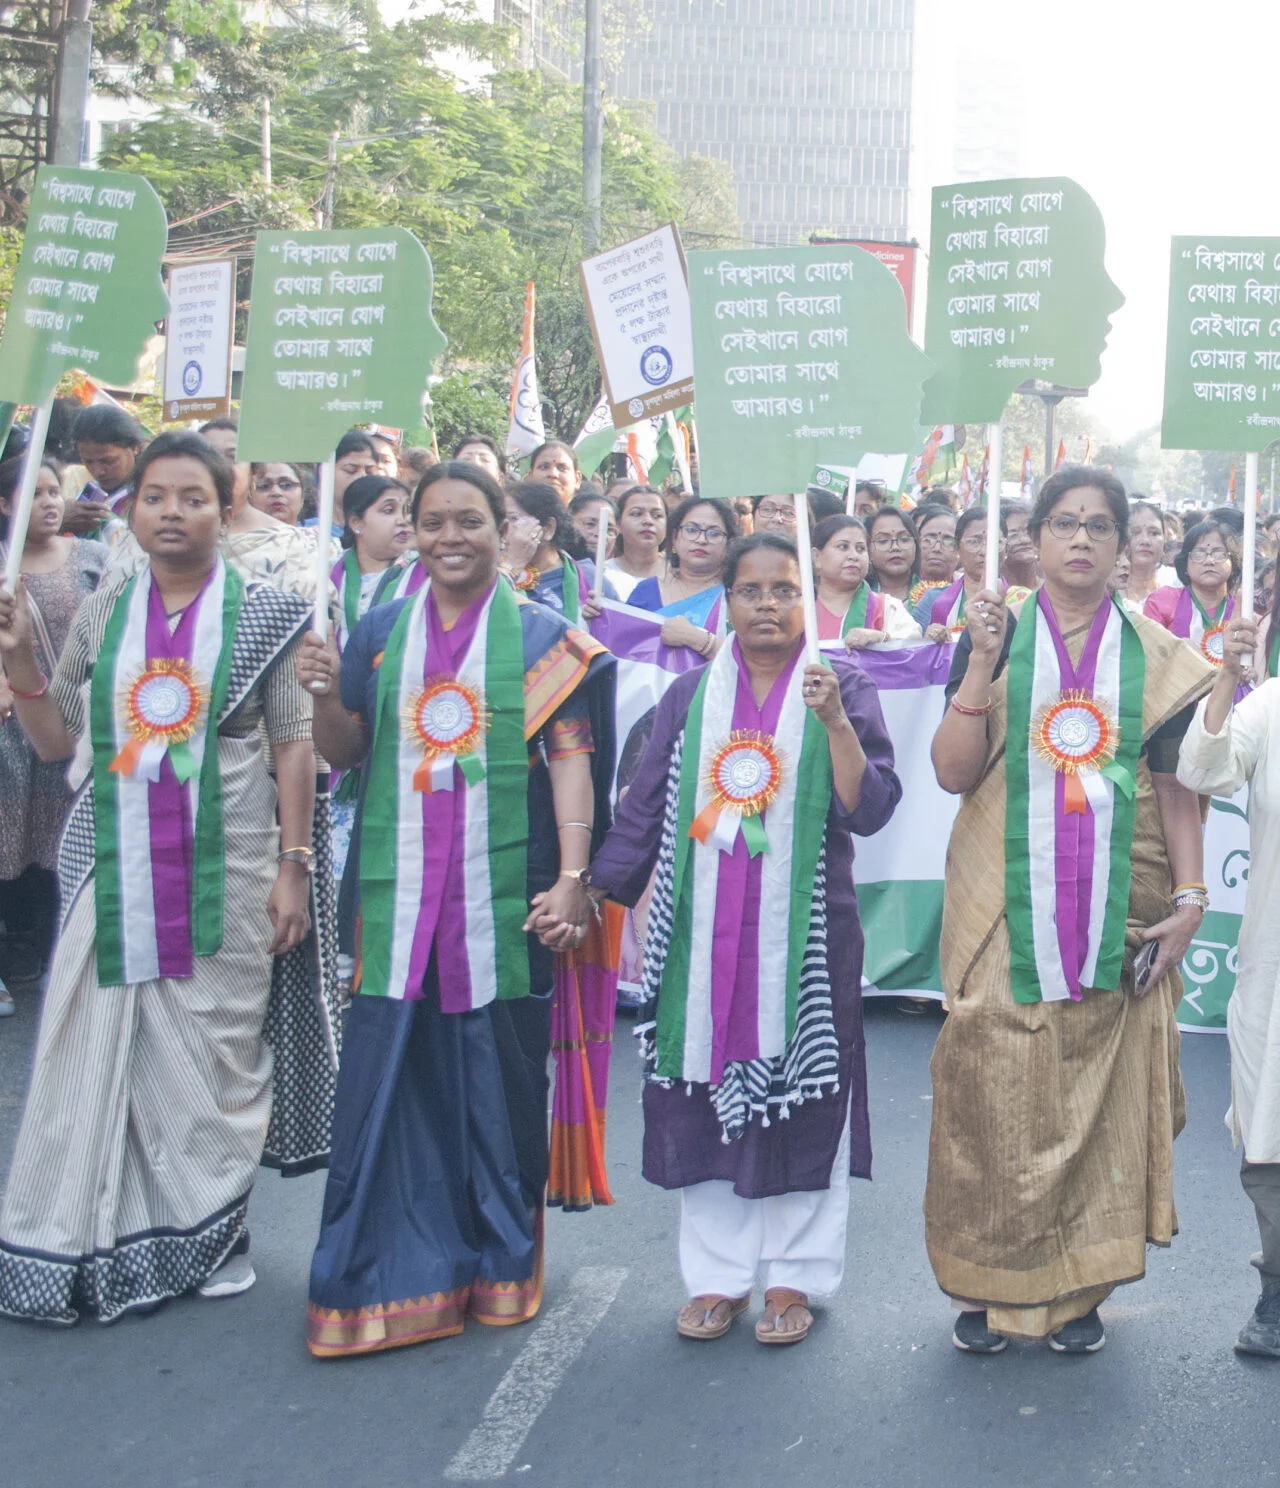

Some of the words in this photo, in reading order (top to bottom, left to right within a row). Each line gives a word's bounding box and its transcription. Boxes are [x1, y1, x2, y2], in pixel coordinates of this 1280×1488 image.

[97, 188, 136, 211] যোগে
[1020, 190, 1063, 213] যোগে
[38, 214, 69, 233] যেথায়
[71, 211, 118, 240] বিহারো
[946, 229, 988, 251] যেথায়
[994, 222, 1049, 248] বিহারো
[33, 242, 80, 268] সেইখানে
[81, 251, 115, 273] যোগ
[356, 241, 398, 262] যোগে
[273, 276, 323, 295] যেথায়
[328, 270, 384, 295] বিহারো
[805, 260, 854, 282] যোগে
[948, 258, 1009, 283] সেইখানে
[1016, 257, 1052, 279] যোগ
[28, 277, 64, 298] তোমার
[67, 281, 99, 304] সাথে
[948, 294, 996, 316] তোমার
[1002, 290, 1041, 312] সাথে
[1188, 283, 1237, 304] যেথায়
[274, 303, 344, 328] সেইখানে
[350, 304, 385, 325] যোগ
[715, 298, 768, 319] যেথায়
[776, 291, 841, 317] বিহারো
[1190, 312, 1261, 337] সেইখানে
[273, 338, 331, 357] তোমার
[335, 337, 374, 357] সাথে
[721, 327, 798, 352] সেইখানে
[808, 326, 848, 348] যোগ
[1033, 354, 1054, 371] ঠাকুর
[1191, 349, 1247, 369] তোমার
[724, 363, 787, 385] তোমার
[795, 360, 839, 381] সাথে
